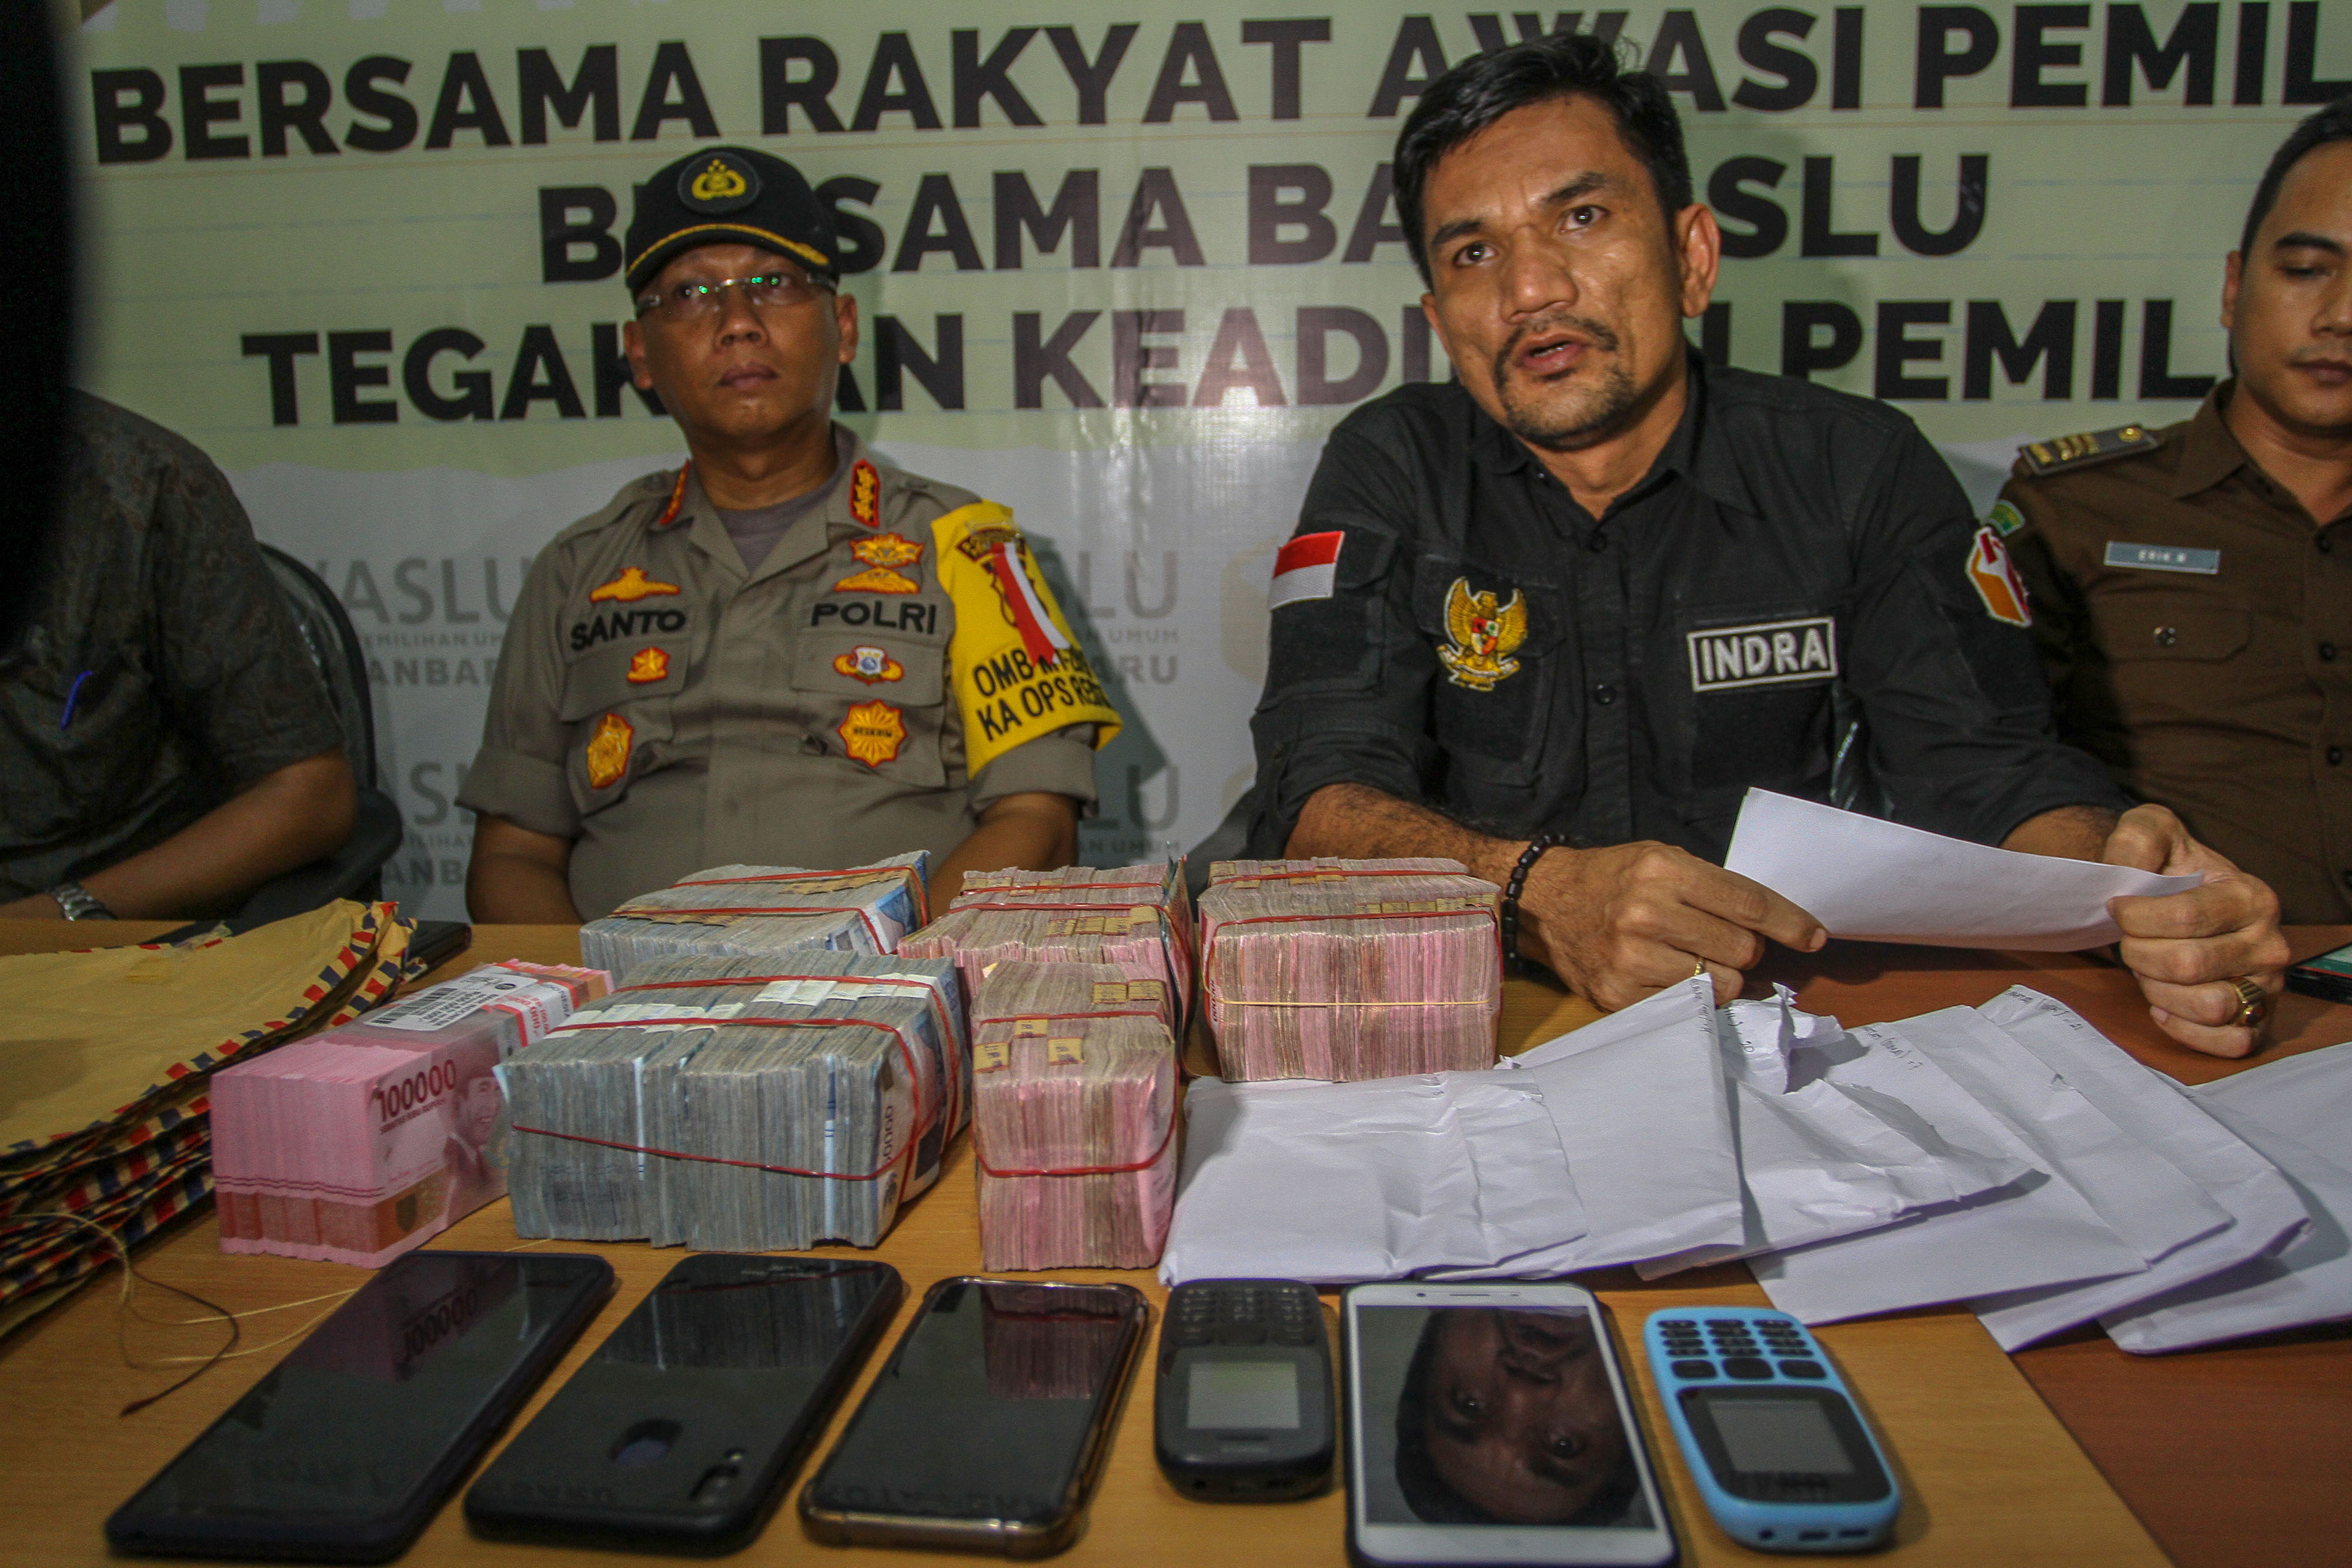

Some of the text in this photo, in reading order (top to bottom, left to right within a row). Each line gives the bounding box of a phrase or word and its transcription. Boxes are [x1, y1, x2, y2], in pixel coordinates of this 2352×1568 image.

[91, 40, 721, 166] BERSAMA
[758, 17, 1332, 135] RAKYAT
[538, 153, 1990, 283] BSAMA BASLU
[241, 311, 963, 427] TEGAKN
[313, 556, 532, 626] ASLU
[811, 600, 936, 635] POLRI
[571, 610, 686, 651] SANTO
[1700, 627, 1829, 682] INDRA
[973, 648, 1034, 697] OMB
[977, 700, 1023, 741] KA
[1021, 677, 1074, 717] OPS
[373, 1059, 457, 1122] 100000
